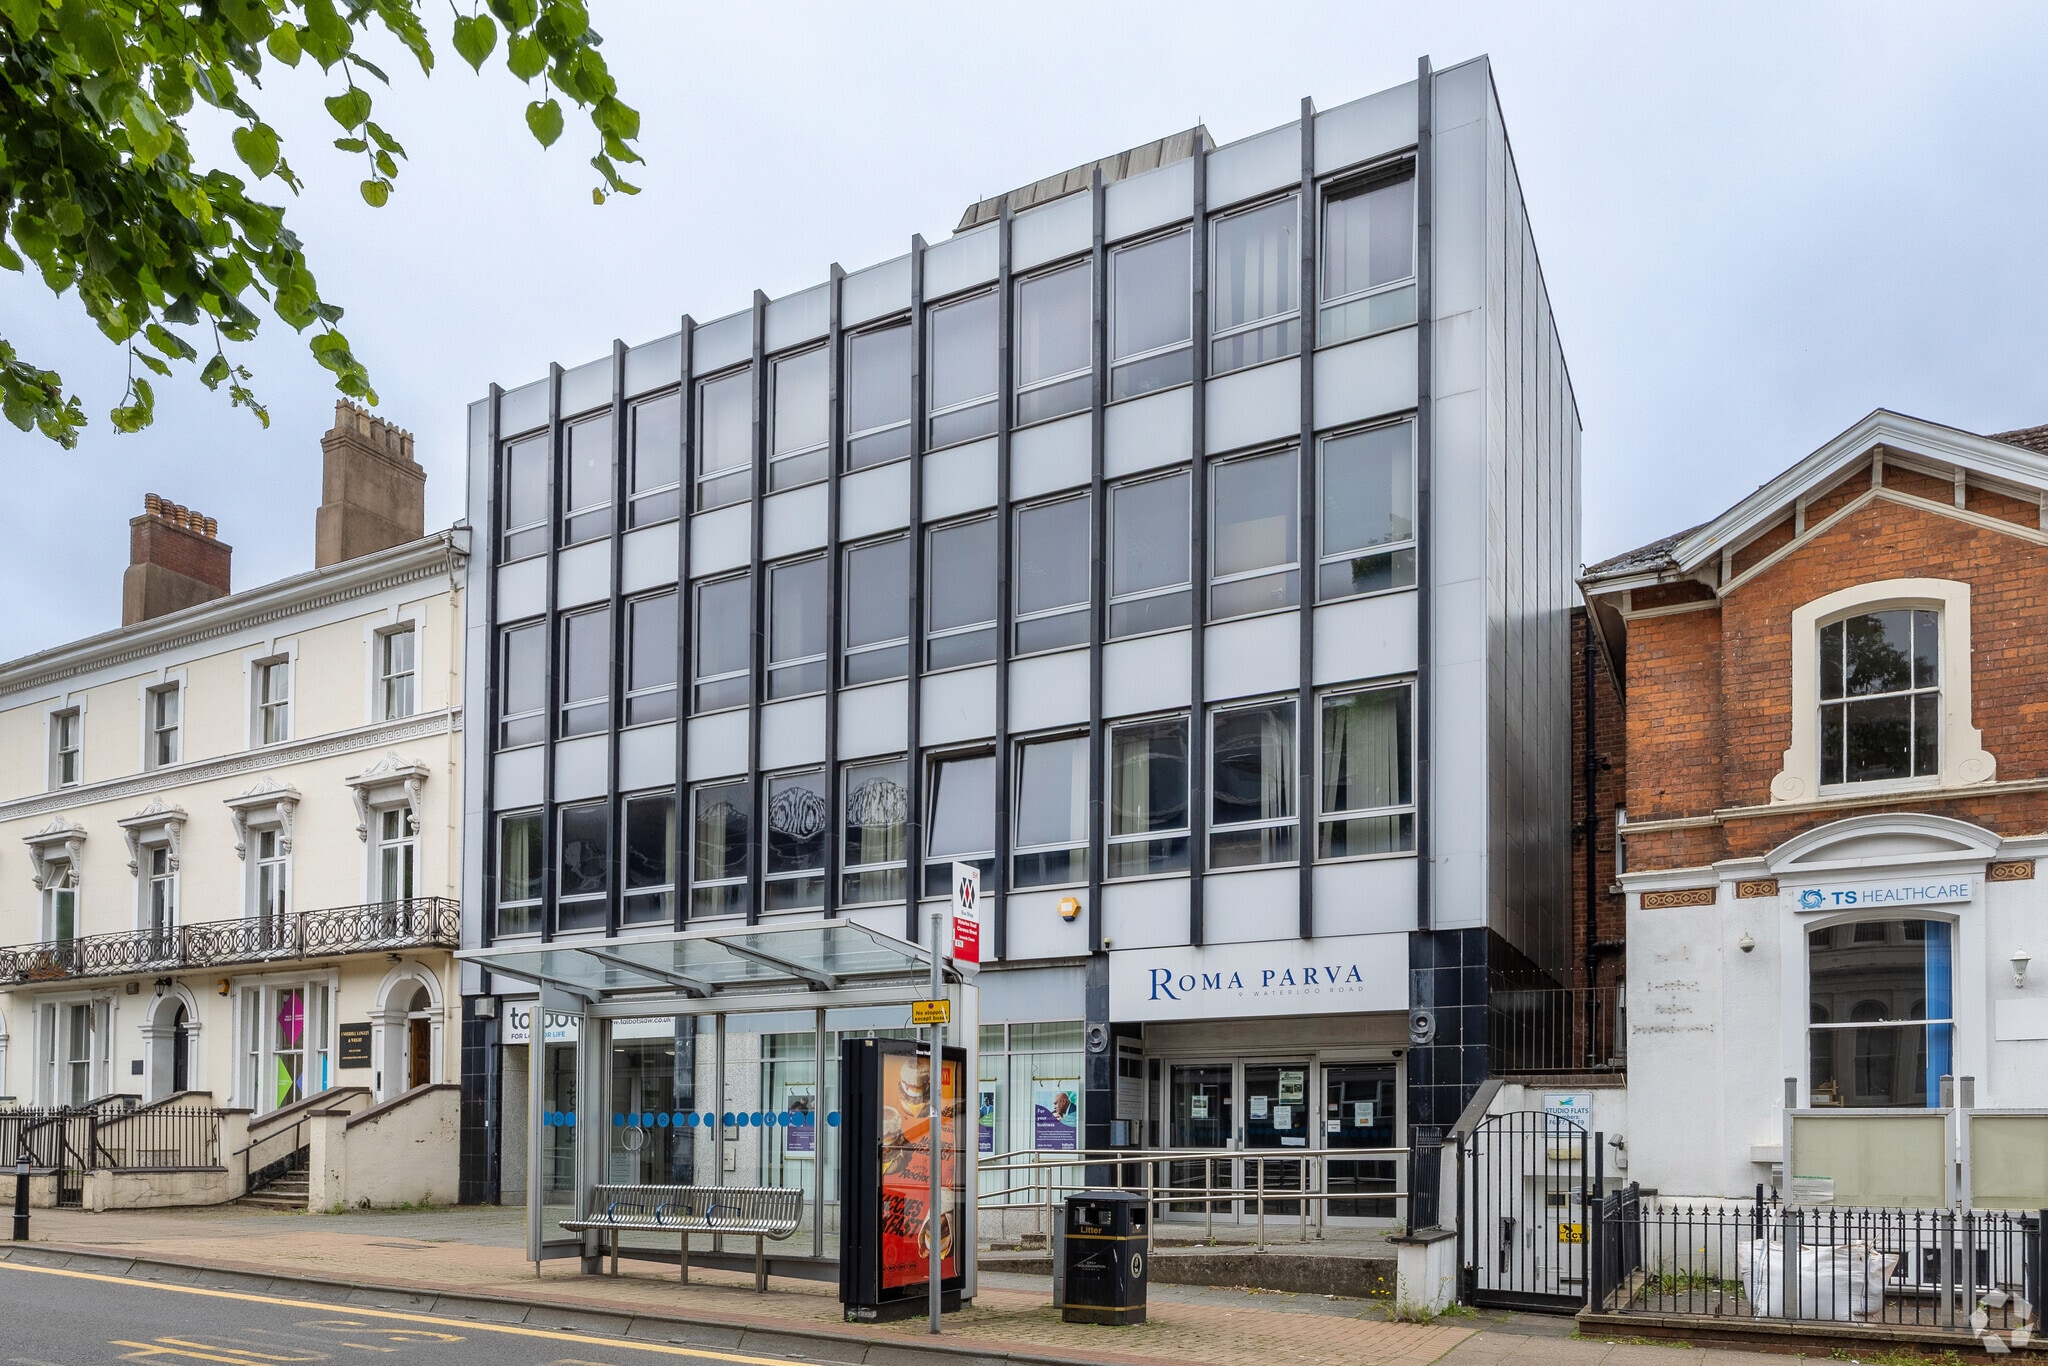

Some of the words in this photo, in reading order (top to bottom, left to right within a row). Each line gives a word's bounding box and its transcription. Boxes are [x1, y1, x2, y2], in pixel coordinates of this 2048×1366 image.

[1831, 891, 1857, 905] TS
[1862, 883, 1968, 902] HEALTHCARE
[1148, 967, 1244, 1001] ROMA
[1261, 964, 1364, 987] PARVA
[1253, 988, 1321, 997] WATERLOO
[1329, 985, 1365, 993] ROAD
[1086, 1024, 1109, 1053] 9
[1409, 1009, 1436, 1044] 9
[1080, 1225, 1103, 1234] Litter
